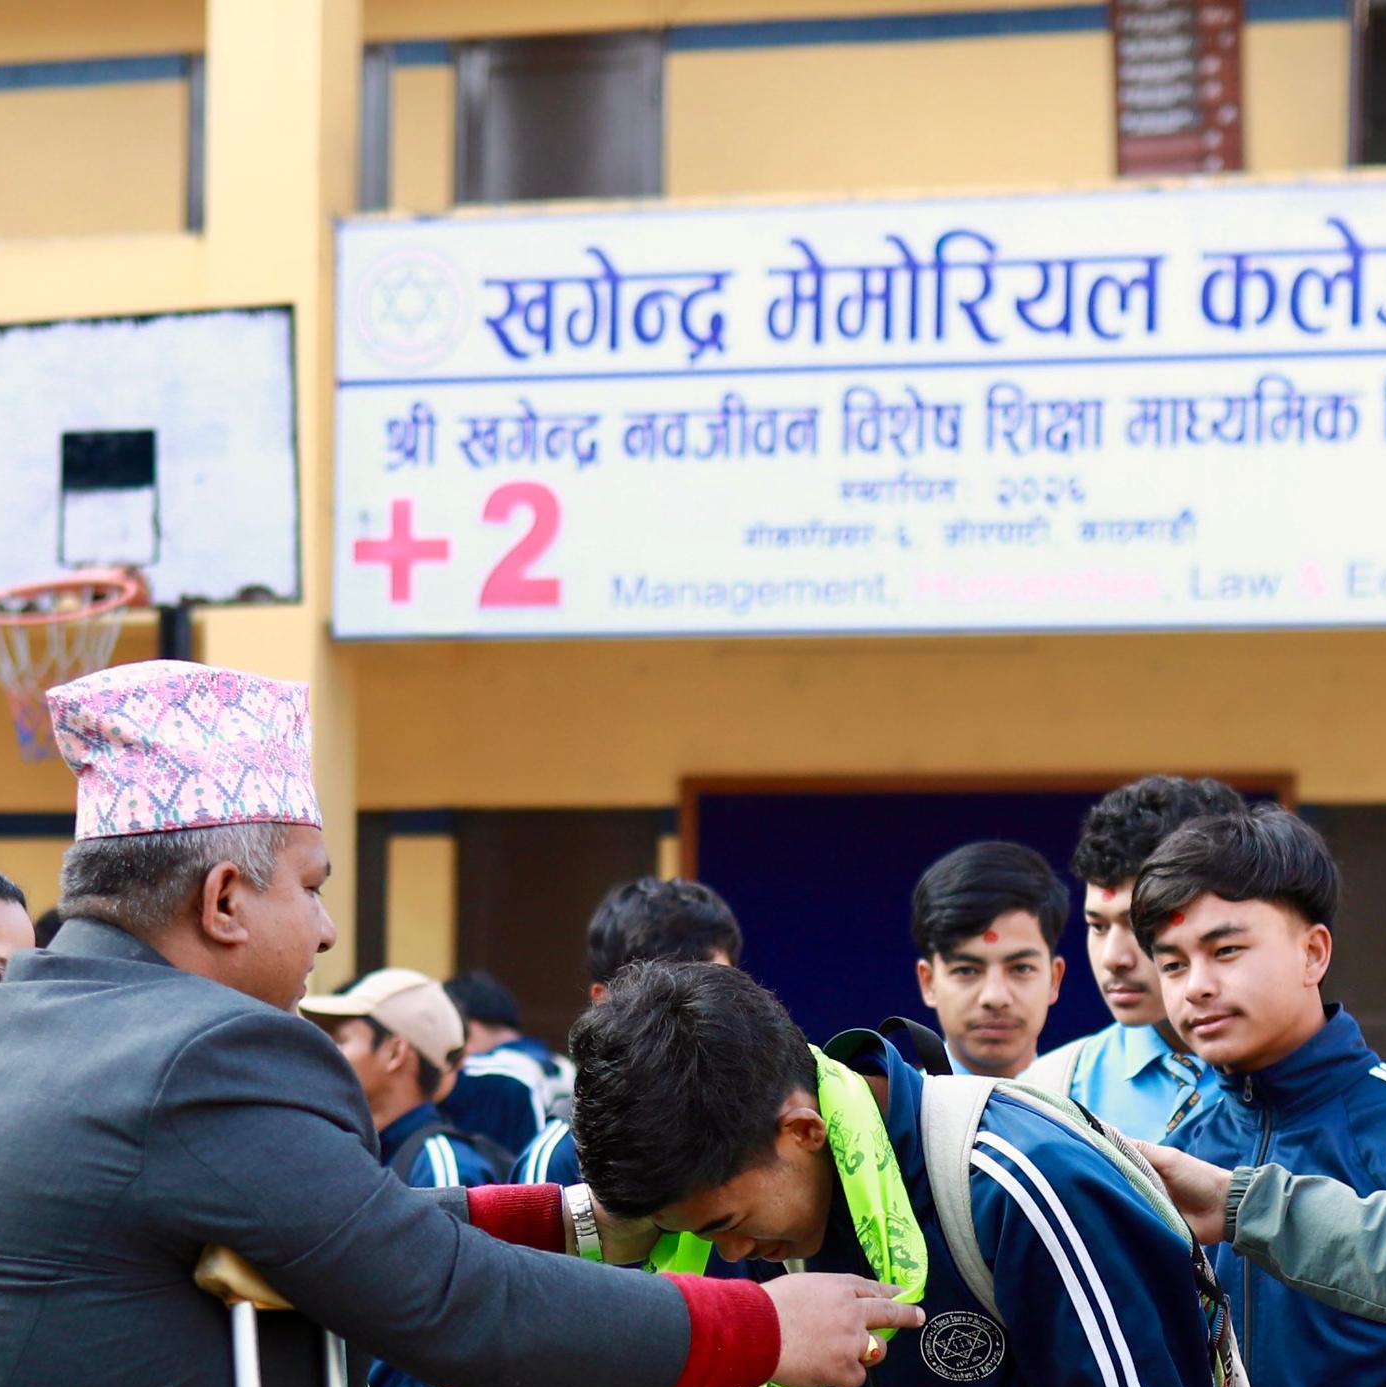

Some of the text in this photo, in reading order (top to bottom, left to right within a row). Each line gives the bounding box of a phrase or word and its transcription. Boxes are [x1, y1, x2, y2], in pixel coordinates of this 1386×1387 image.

[483, 246, 735, 362] खगेन्द्र
[768, 227, 1169, 345] मेमोरियल
[384, 400, 436, 471] श्री
[456, 398, 602, 469] खगेन्द्र
[622, 391, 821, 462] नवजीवन
[840, 384, 964, 459] विशेष
[984, 380, 1104, 455] शिक्षा
[1125, 373, 1360, 448] माध्यमिक
[611, 573, 900, 614] Management,
[1190, 564, 1282, 601] Law
